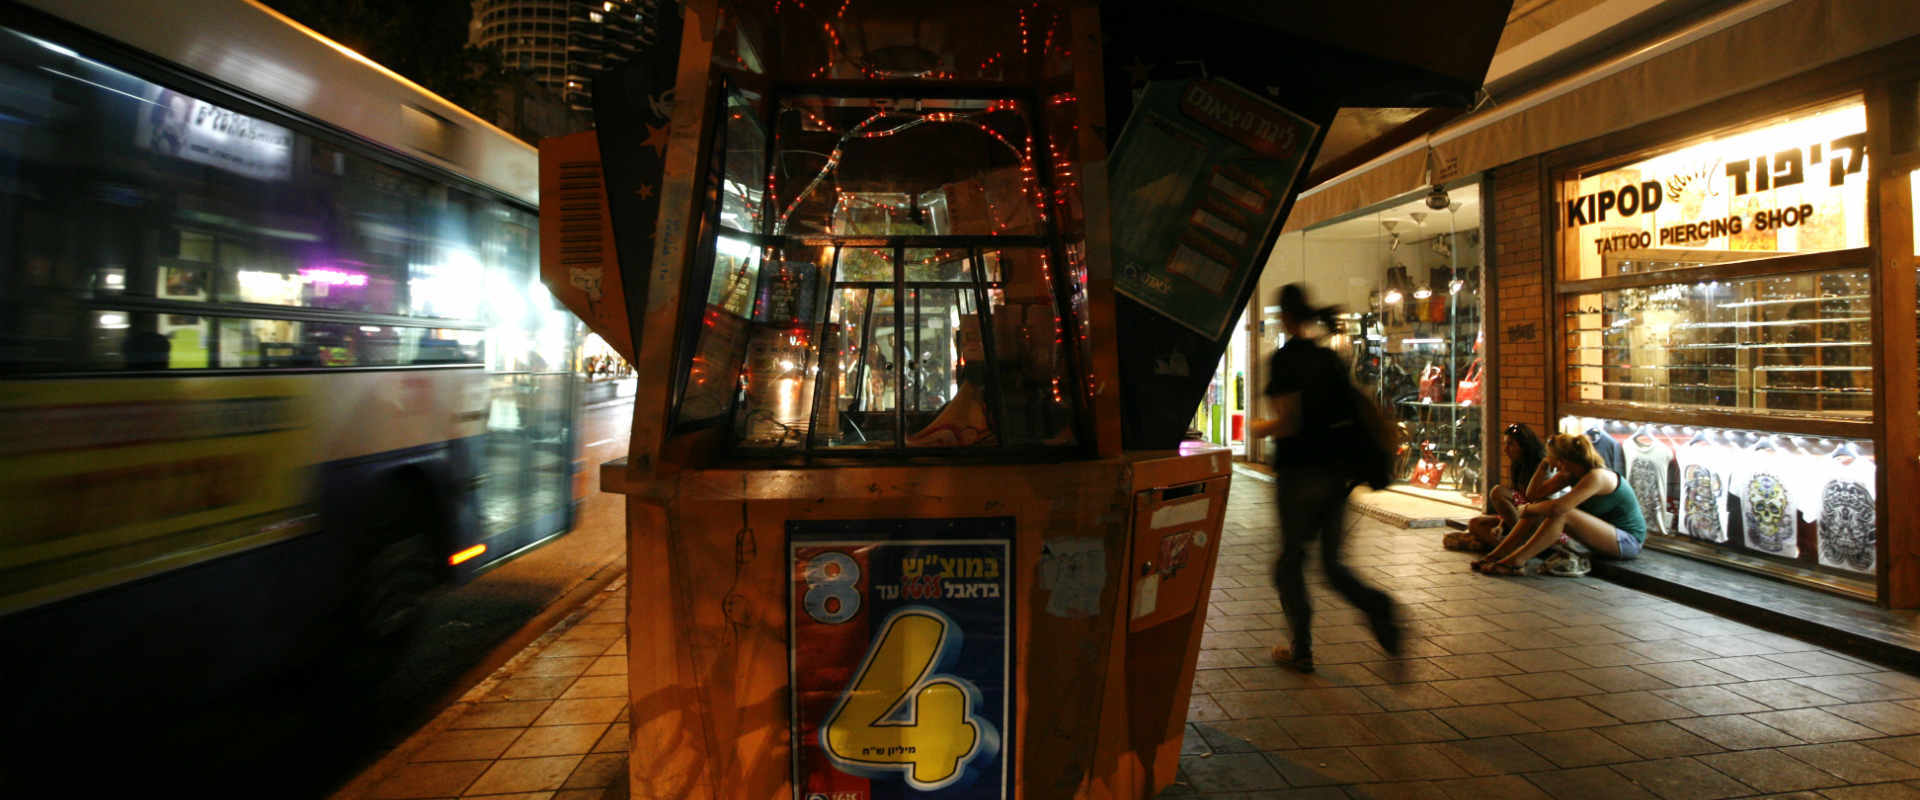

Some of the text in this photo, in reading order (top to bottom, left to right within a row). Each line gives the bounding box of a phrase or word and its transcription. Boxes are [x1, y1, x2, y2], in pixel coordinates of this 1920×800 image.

[1726, 131, 1868, 196] קיפוד
[1568, 180, 1663, 227] KIPOD
[1595, 203, 1814, 255] TATTOO PIERCING SHOP
[804, 552, 861, 624] 8
[875, 585, 899, 600] עד
[944, 581, 1000, 598] בדאבל
[824, 611, 978, 786] 4
